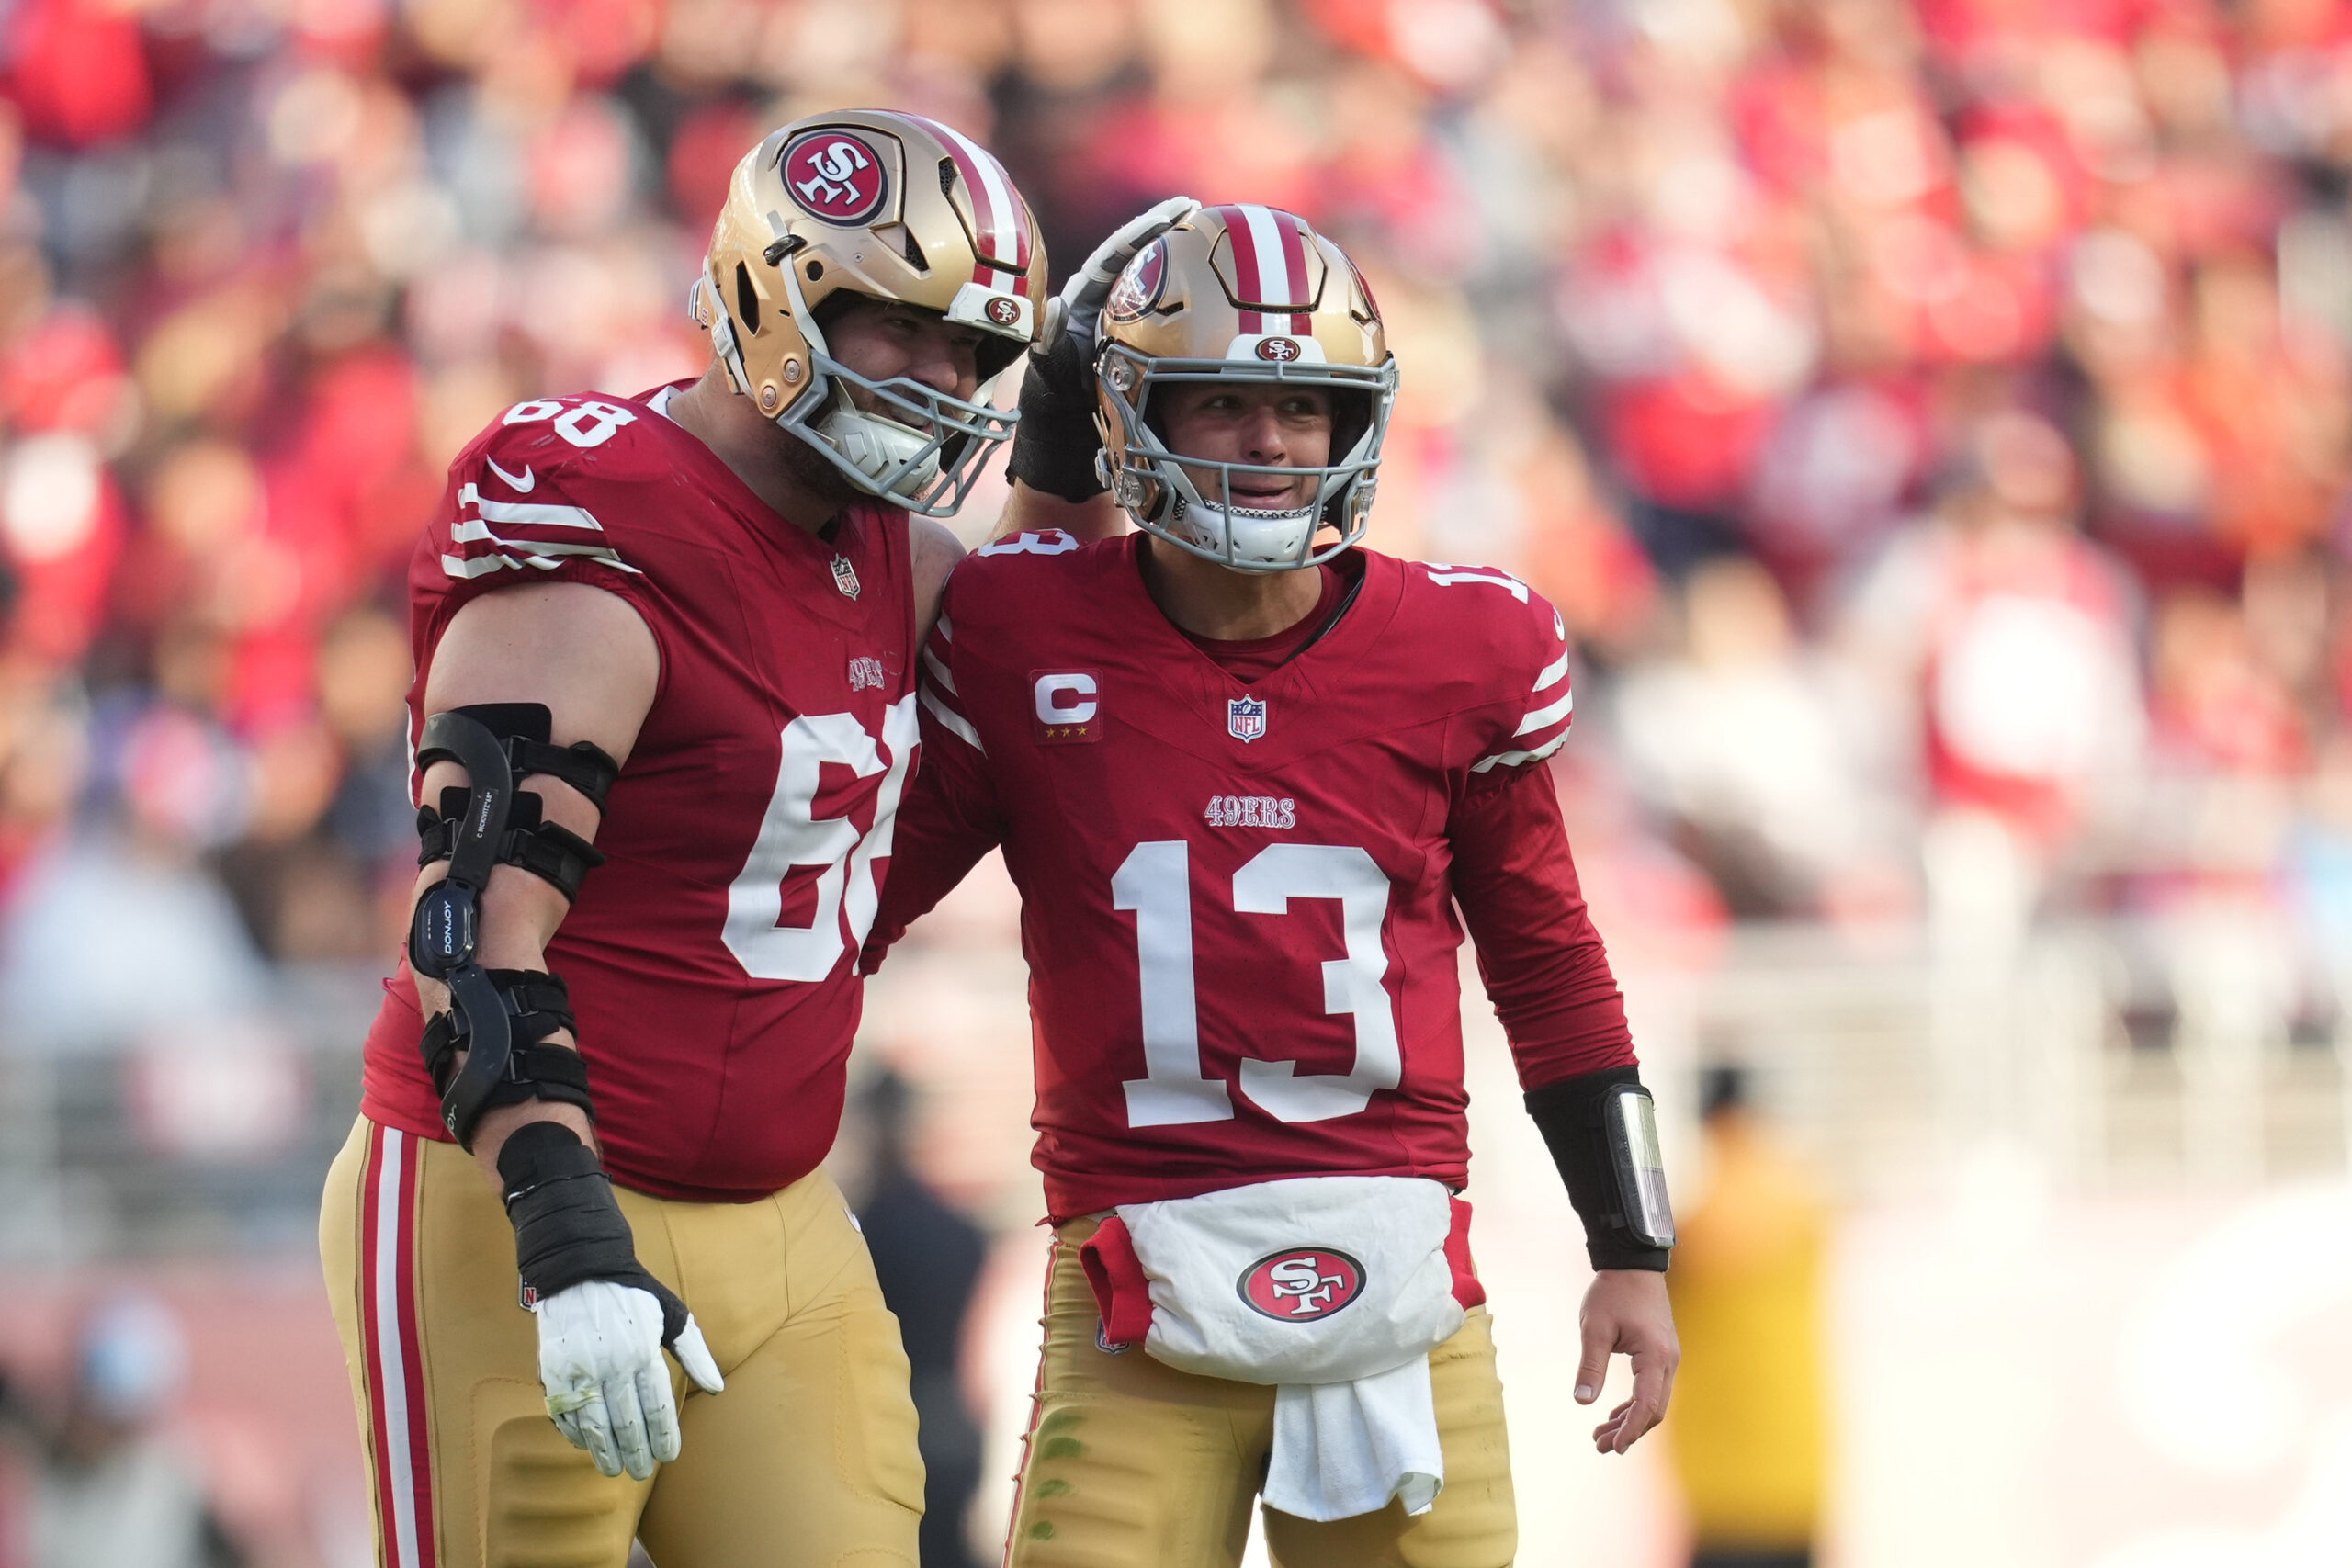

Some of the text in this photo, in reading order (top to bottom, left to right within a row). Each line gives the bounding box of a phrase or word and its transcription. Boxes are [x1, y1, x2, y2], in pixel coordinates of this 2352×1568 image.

[503, 397, 639, 448] 68
[1035, 673, 1097, 725] C
[1233, 716, 1261, 733] NFL
[1204, 795, 1296, 829] 49ERS
[444, 900, 452, 954] DONJOY
[1110, 840, 1402, 1129] 13
